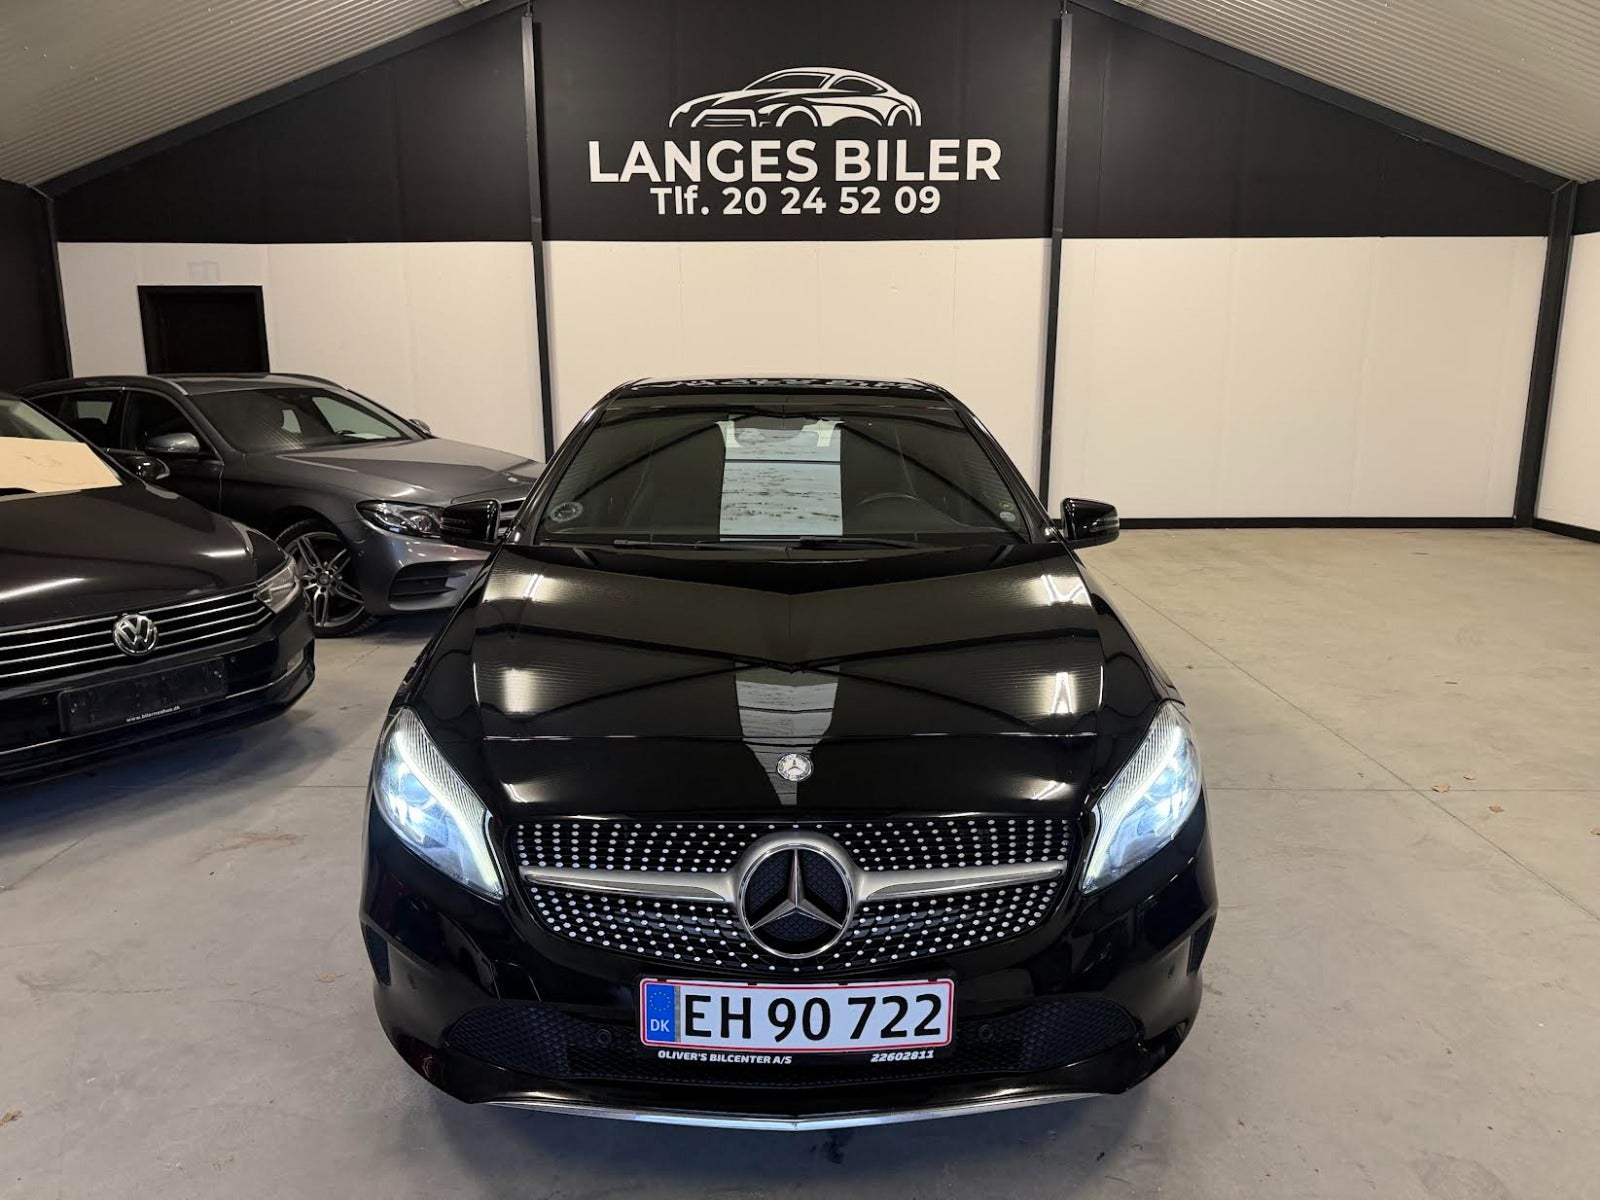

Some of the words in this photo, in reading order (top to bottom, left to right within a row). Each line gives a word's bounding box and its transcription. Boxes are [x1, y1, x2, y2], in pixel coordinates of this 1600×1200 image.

[588, 139, 819, 183] LANGES
[834, 138, 1002, 182] BILER
[650, 185, 710, 215] Tlf.
[722, 187, 767, 215] 20
[780, 187, 827, 215] 24
[838, 187, 881, 215] 52
[894, 186, 941, 215] 09
[650, 1018, 670, 1033] DK
[684, 994, 752, 1040] EH
[767, 997, 831, 1043] 90
[847, 993, 943, 1040] 722
[657, 1050, 707, 1062] OLIVER'S
[709, 1053, 771, 1064] BILCENTER
[772, 1055, 793, 1065] A/S
